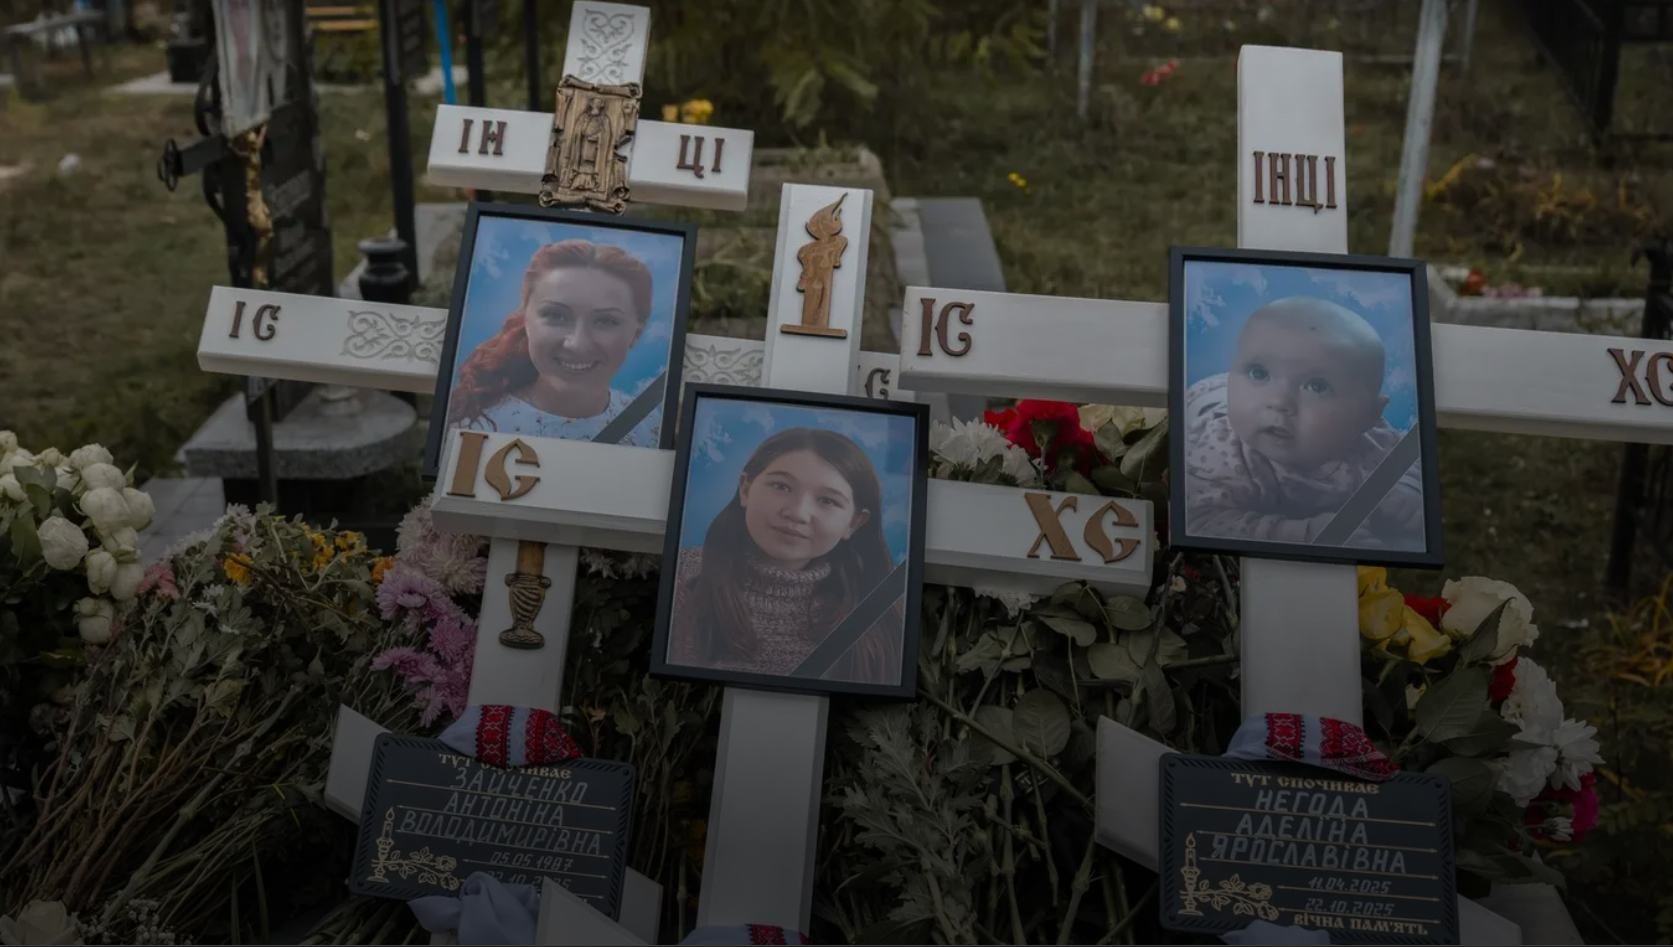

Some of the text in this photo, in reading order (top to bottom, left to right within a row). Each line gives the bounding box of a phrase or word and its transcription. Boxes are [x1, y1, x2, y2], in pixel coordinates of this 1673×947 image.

[1253, 151, 1337, 215] ІНЦІ
[1231, 772, 1380, 795] ТУТ СПОЧИВАЄ
[443, 790, 564, 828] АНТОНІНА
[1255, 789, 1369, 821] НЕГОДА
[400, 809, 601, 857] ВОЛОДИМИРІВНА
[1234, 813, 1369, 845] АДЕЛІНА
[1210, 834, 1407, 875] ЯРОСЛАВІВНА
[1307, 876, 1392, 895] 11.04.2025
[1304, 897, 1395, 917] 22.10.2025
